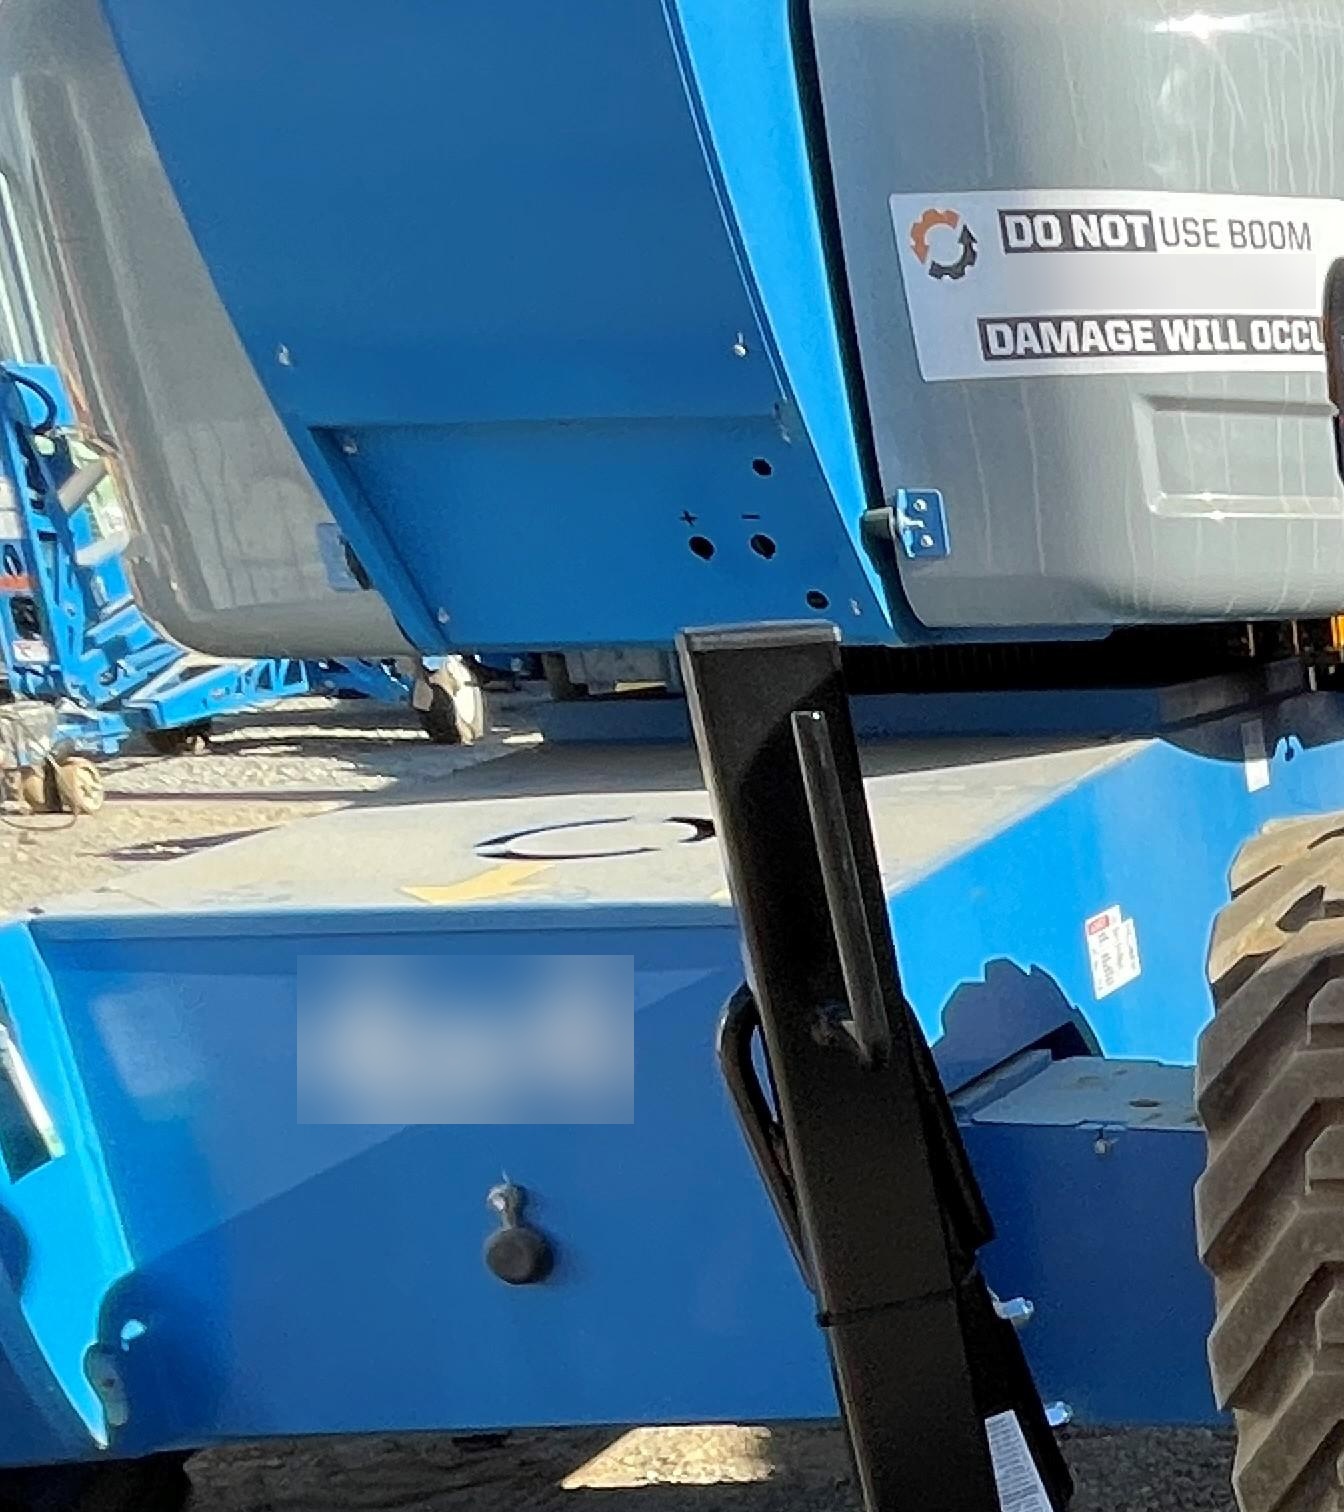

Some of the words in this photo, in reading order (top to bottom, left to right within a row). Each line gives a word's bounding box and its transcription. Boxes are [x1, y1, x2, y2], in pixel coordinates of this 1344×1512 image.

[1005, 214, 1062, 247] DO
[1072, 214, 1150, 247] NOT
[1158, 216, 1221, 249] USE
[1229, 218, 1313, 251] BOOM
[986, 318, 1157, 356] DAMAGE
[1160, 318, 1246, 354] WILL
